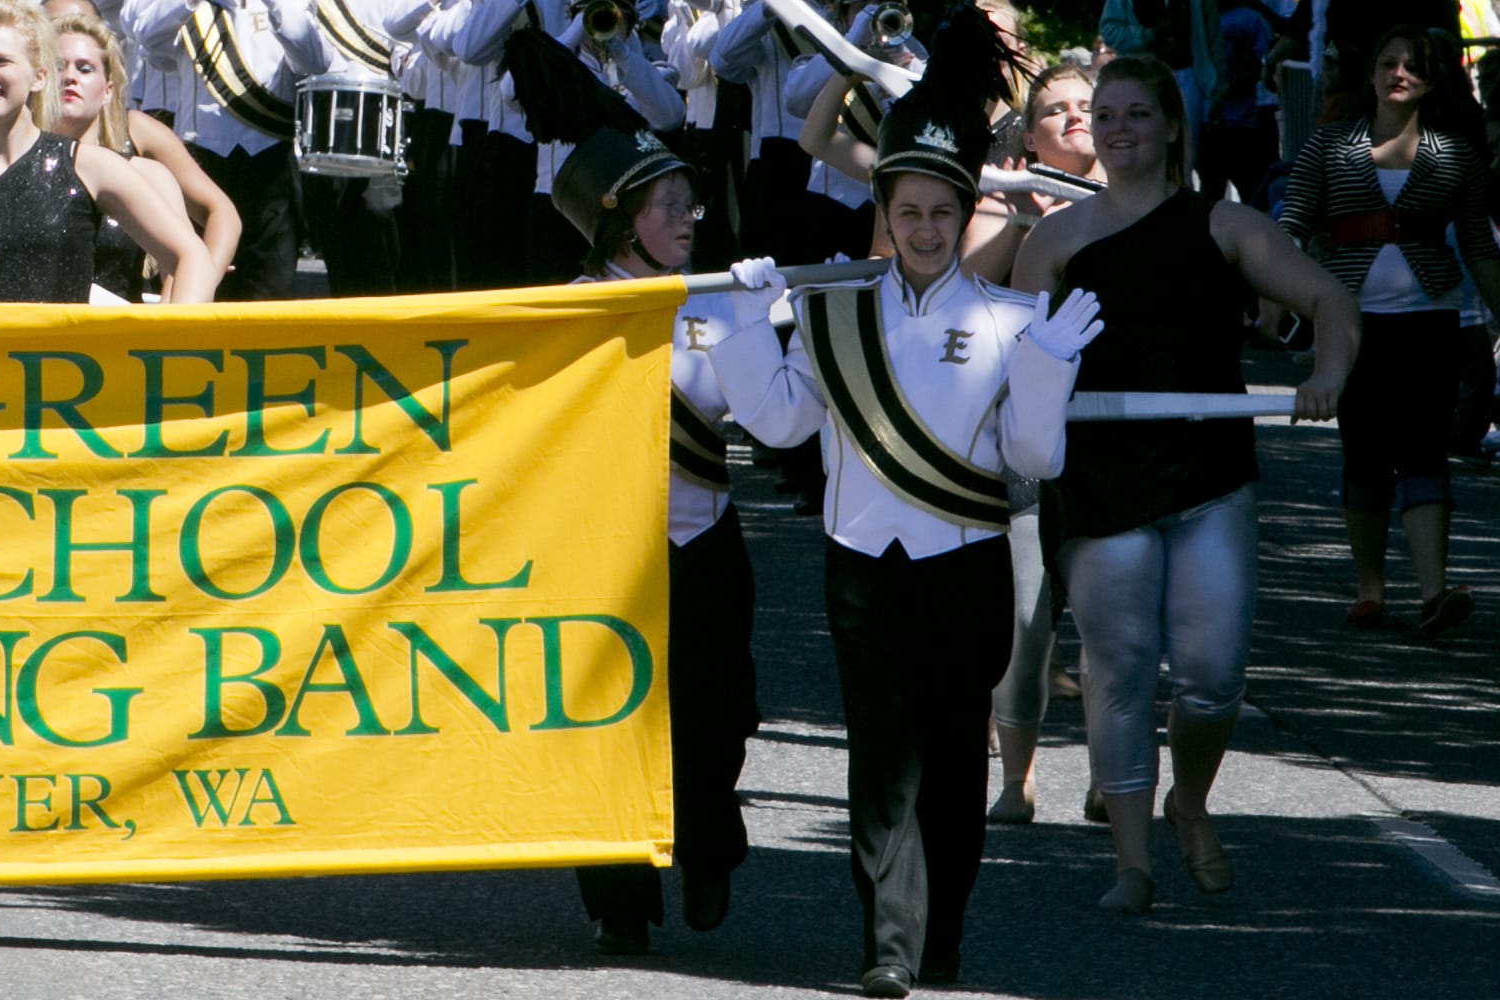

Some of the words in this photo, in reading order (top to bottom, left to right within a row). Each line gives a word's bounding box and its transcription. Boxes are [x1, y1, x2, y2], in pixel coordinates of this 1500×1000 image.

[249, 11, 268, 33] E
[681, 315, 710, 352] E
[938, 328, 975, 365] E
[188, 614, 654, 740] BAND
[173, 767, 297, 828] WA
